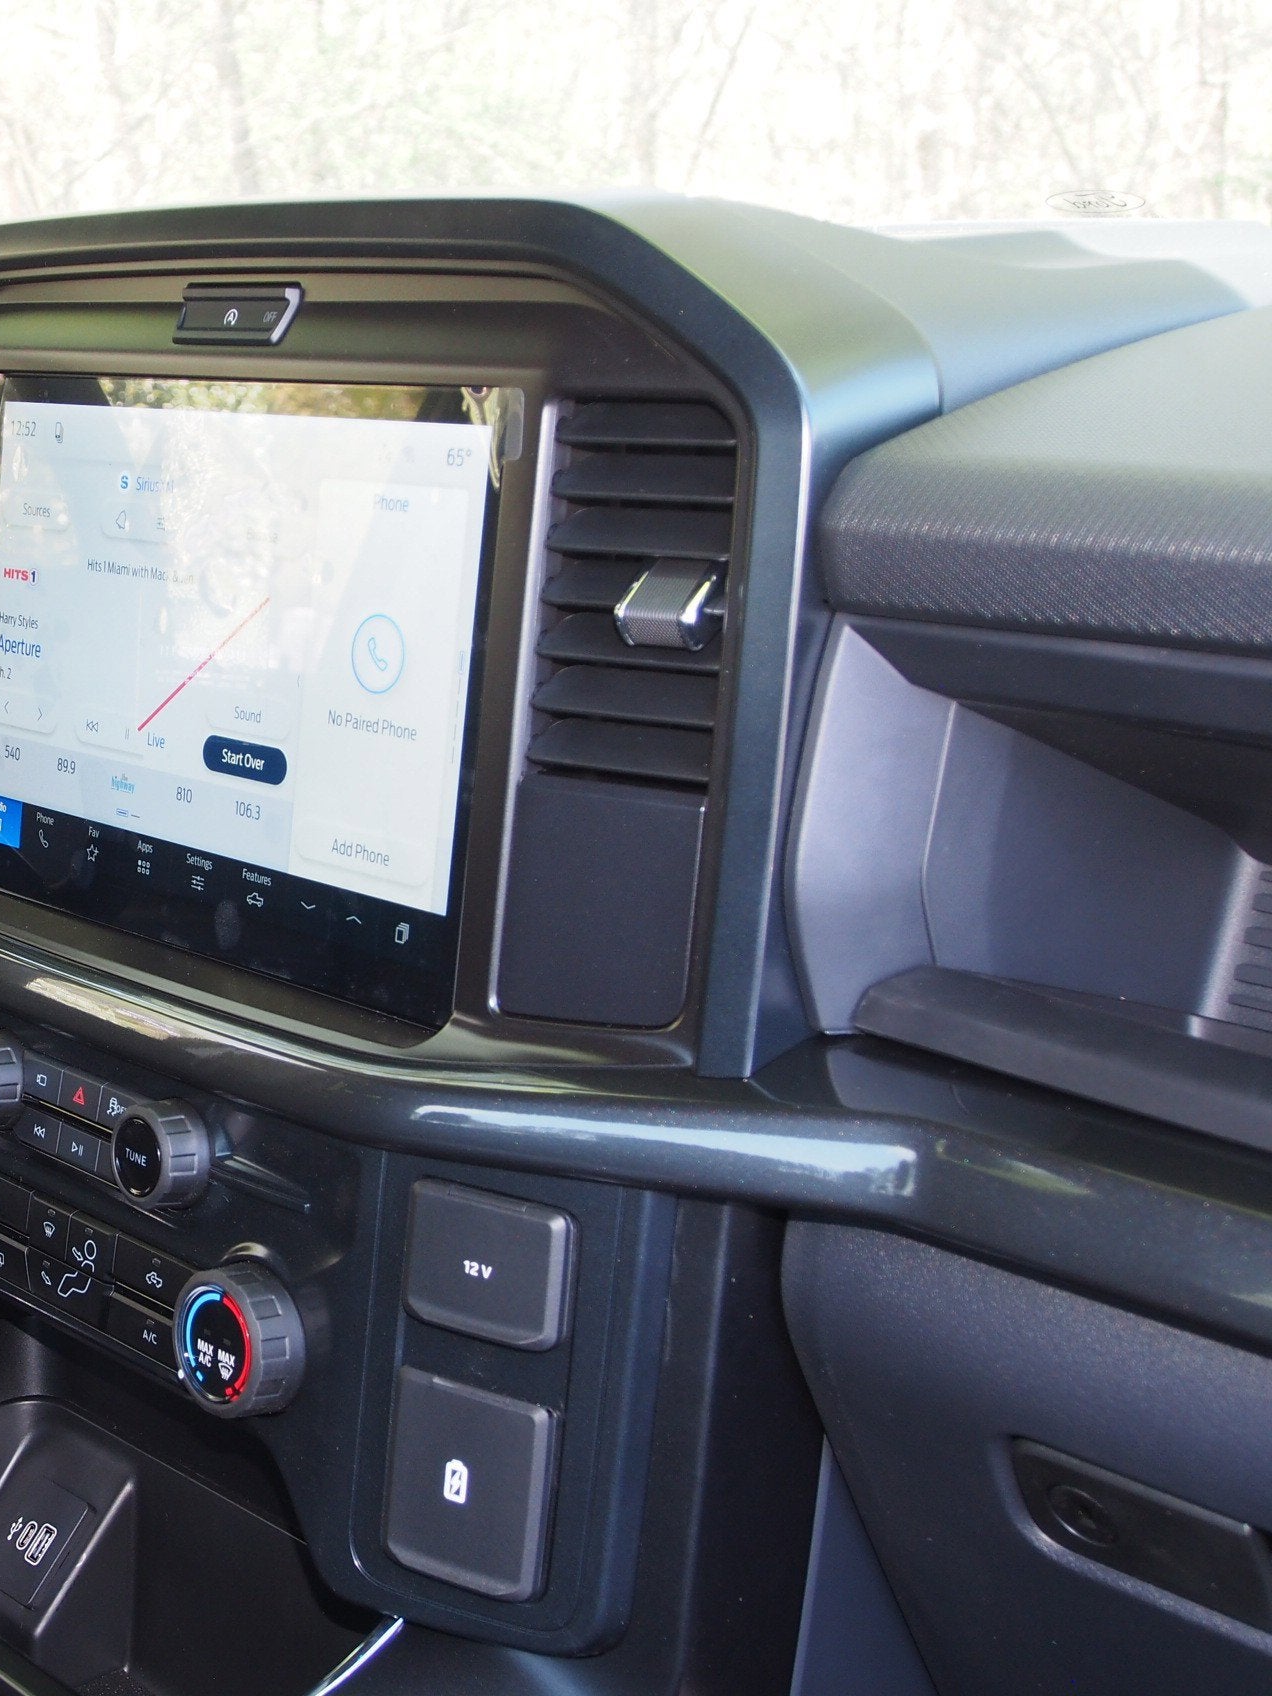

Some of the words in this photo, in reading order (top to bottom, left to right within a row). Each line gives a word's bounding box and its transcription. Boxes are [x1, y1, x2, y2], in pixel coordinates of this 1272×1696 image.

[263, 311, 278, 323] OFF
[10, 420, 36, 437] 12:52
[22, 503, 51, 518] Sources
[87, 558, 102, 572] Hits
[107, 562, 131, 577] Miami
[131, 563, 149, 579] with
[0, 611, 16, 628] Harry
[17, 615, 39, 630] Styles
[7, 667, 12, 680] 2
[234, 706, 262, 723] Sound
[328, 710, 343, 727] No
[345, 713, 379, 733] Paired
[381, 718, 417, 741] Phone
[147, 732, 165, 749] Live
[4, 745, 21, 761] 540
[221, 748, 243, 766] Start
[244, 752, 265, 771] Over
[57, 757, 76, 775] 89.9
[176, 787, 193, 803] 810
[36, 812, 54, 826] Phone
[235, 801, 261, 821] 106.3
[88, 826, 100, 838] Fav
[137, 840, 154, 854] Apps
[331, 838, 352, 857] Add
[355, 842, 390, 867] Phone
[186, 853, 213, 870] Settings
[242, 868, 272, 887] Features
[125, 1148, 147, 1167] TUNE
[142, 1328, 158, 1345] A/C
[197, 1338, 214, 1357] MAX
[198, 1351, 212, 1368] A/C
[218, 1349, 236, 1367] MAX
